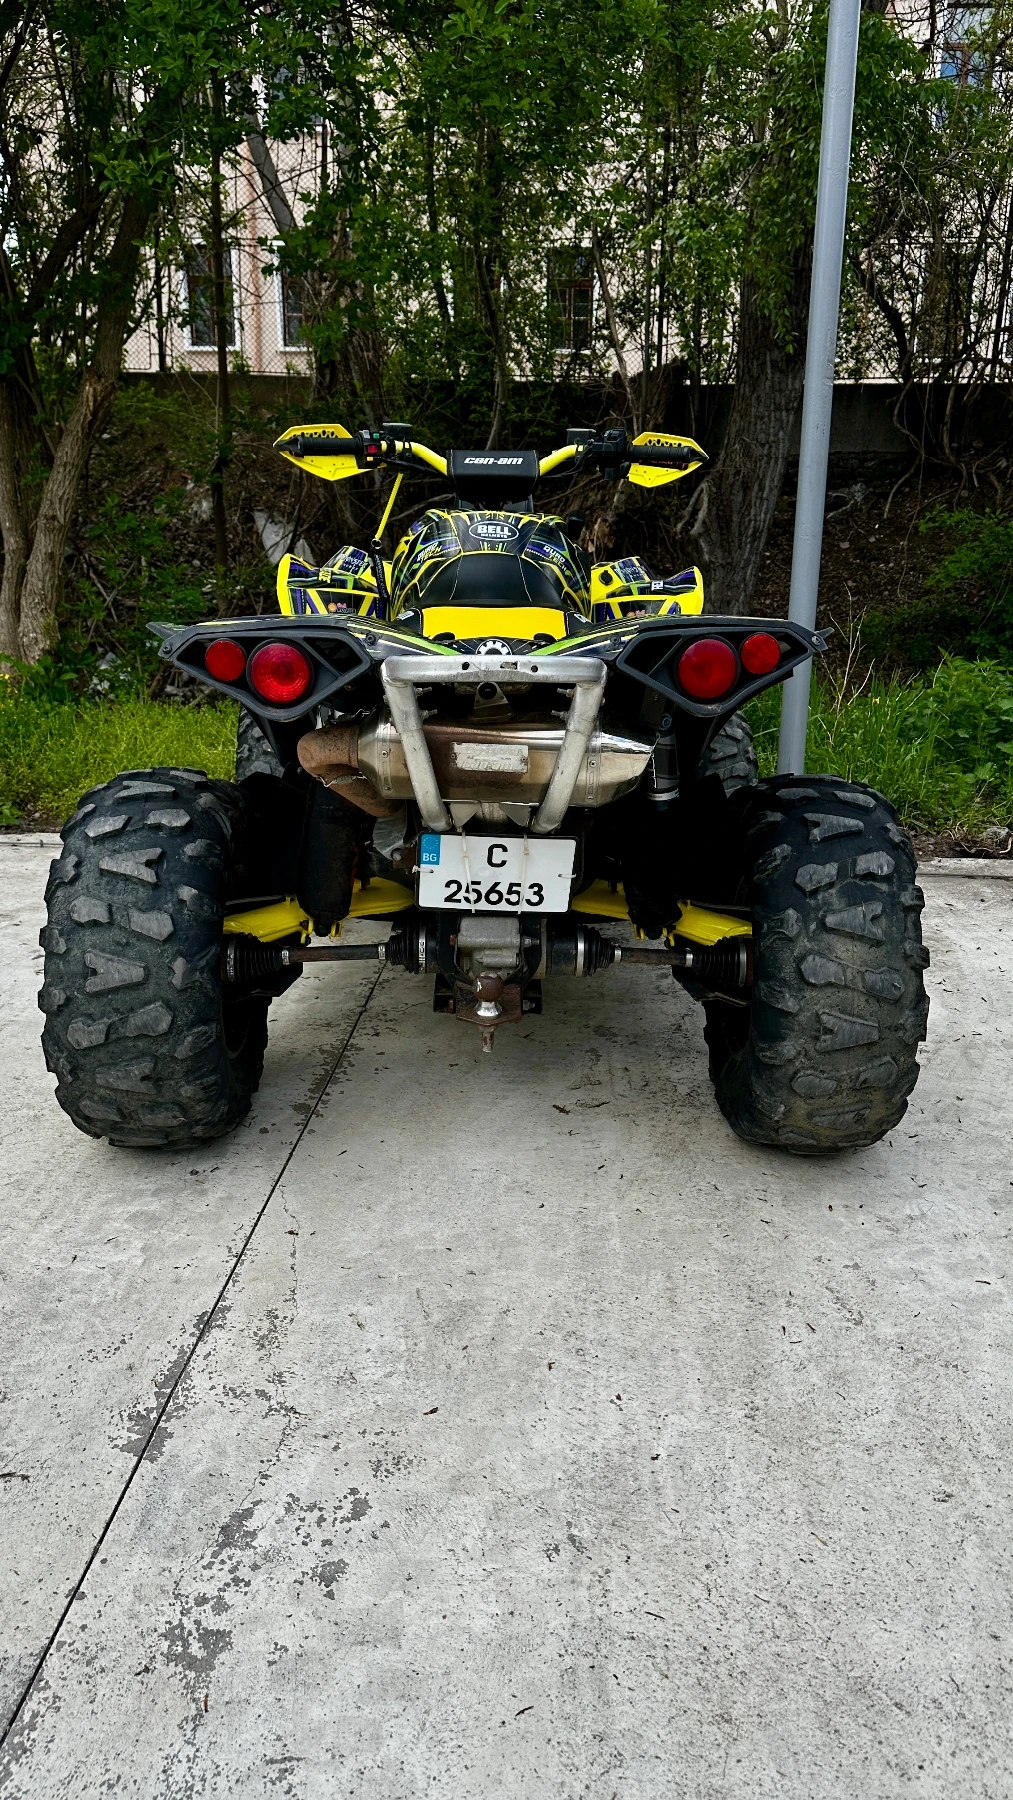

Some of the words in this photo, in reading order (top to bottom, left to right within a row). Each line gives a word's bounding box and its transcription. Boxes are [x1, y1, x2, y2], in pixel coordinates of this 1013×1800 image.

[477, 524, 511, 536] BELL
[422, 853, 437, 862] BG
[486, 843, 508, 868] C
[443, 879, 545, 907] 25653
